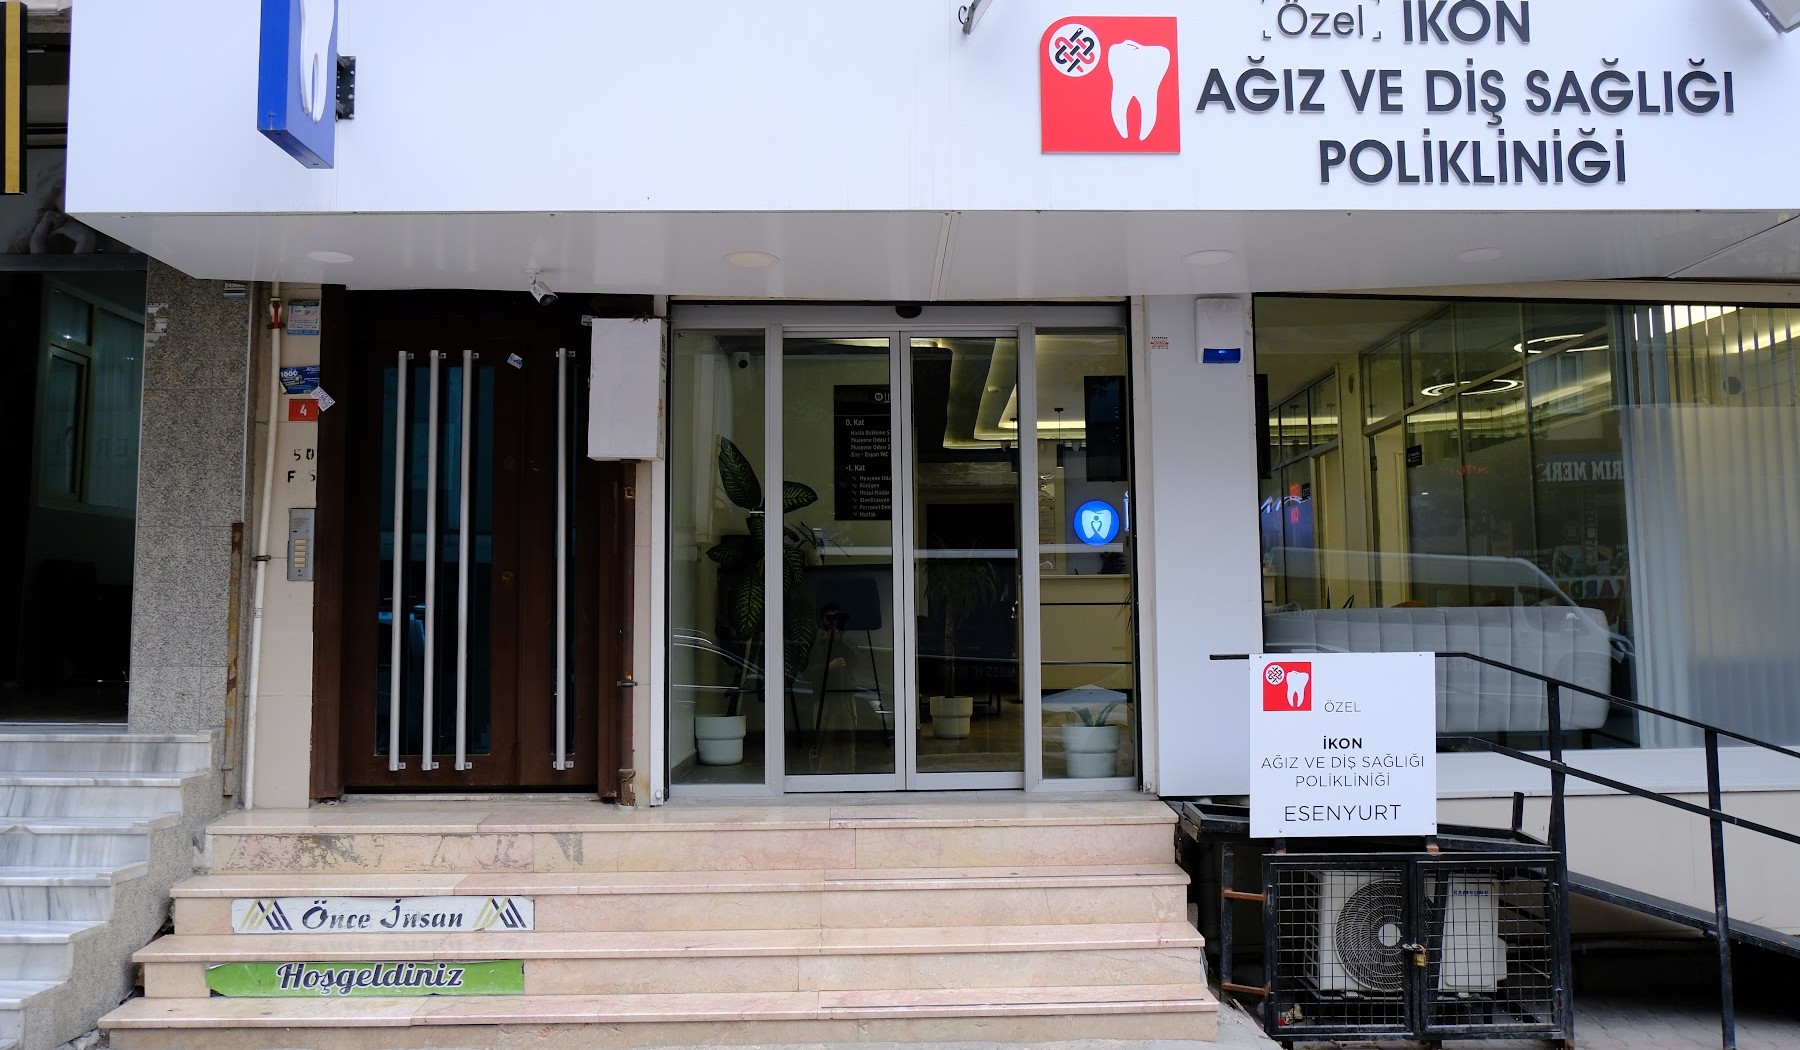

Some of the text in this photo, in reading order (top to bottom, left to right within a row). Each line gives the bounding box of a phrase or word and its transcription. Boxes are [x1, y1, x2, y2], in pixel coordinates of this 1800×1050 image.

[1277, 0, 1364, 37] Özel
[1195, 55, 1735, 127] AĞIZ VE DİŞ SAĞLIĞI
[1318, 127, 1627, 185] POLİKLİNİĞİ
[300, 404, 308, 416] 4
[853, 418, 865, 426] Kat
[1324, 700, 1362, 713] ÖZEL
[1323, 735, 1363, 750] İKON
[1261, 753, 1424, 770] AĞIZ VE DİŞ SAĞLIĞI
[1295, 772, 1390, 788] POLİKLİNİĞİ
[1284, 804, 1402, 822] ESENYURT
[301, 898, 464, 930] Önce İnsan
[276, 962, 466, 996] Hoşgeldiniz
